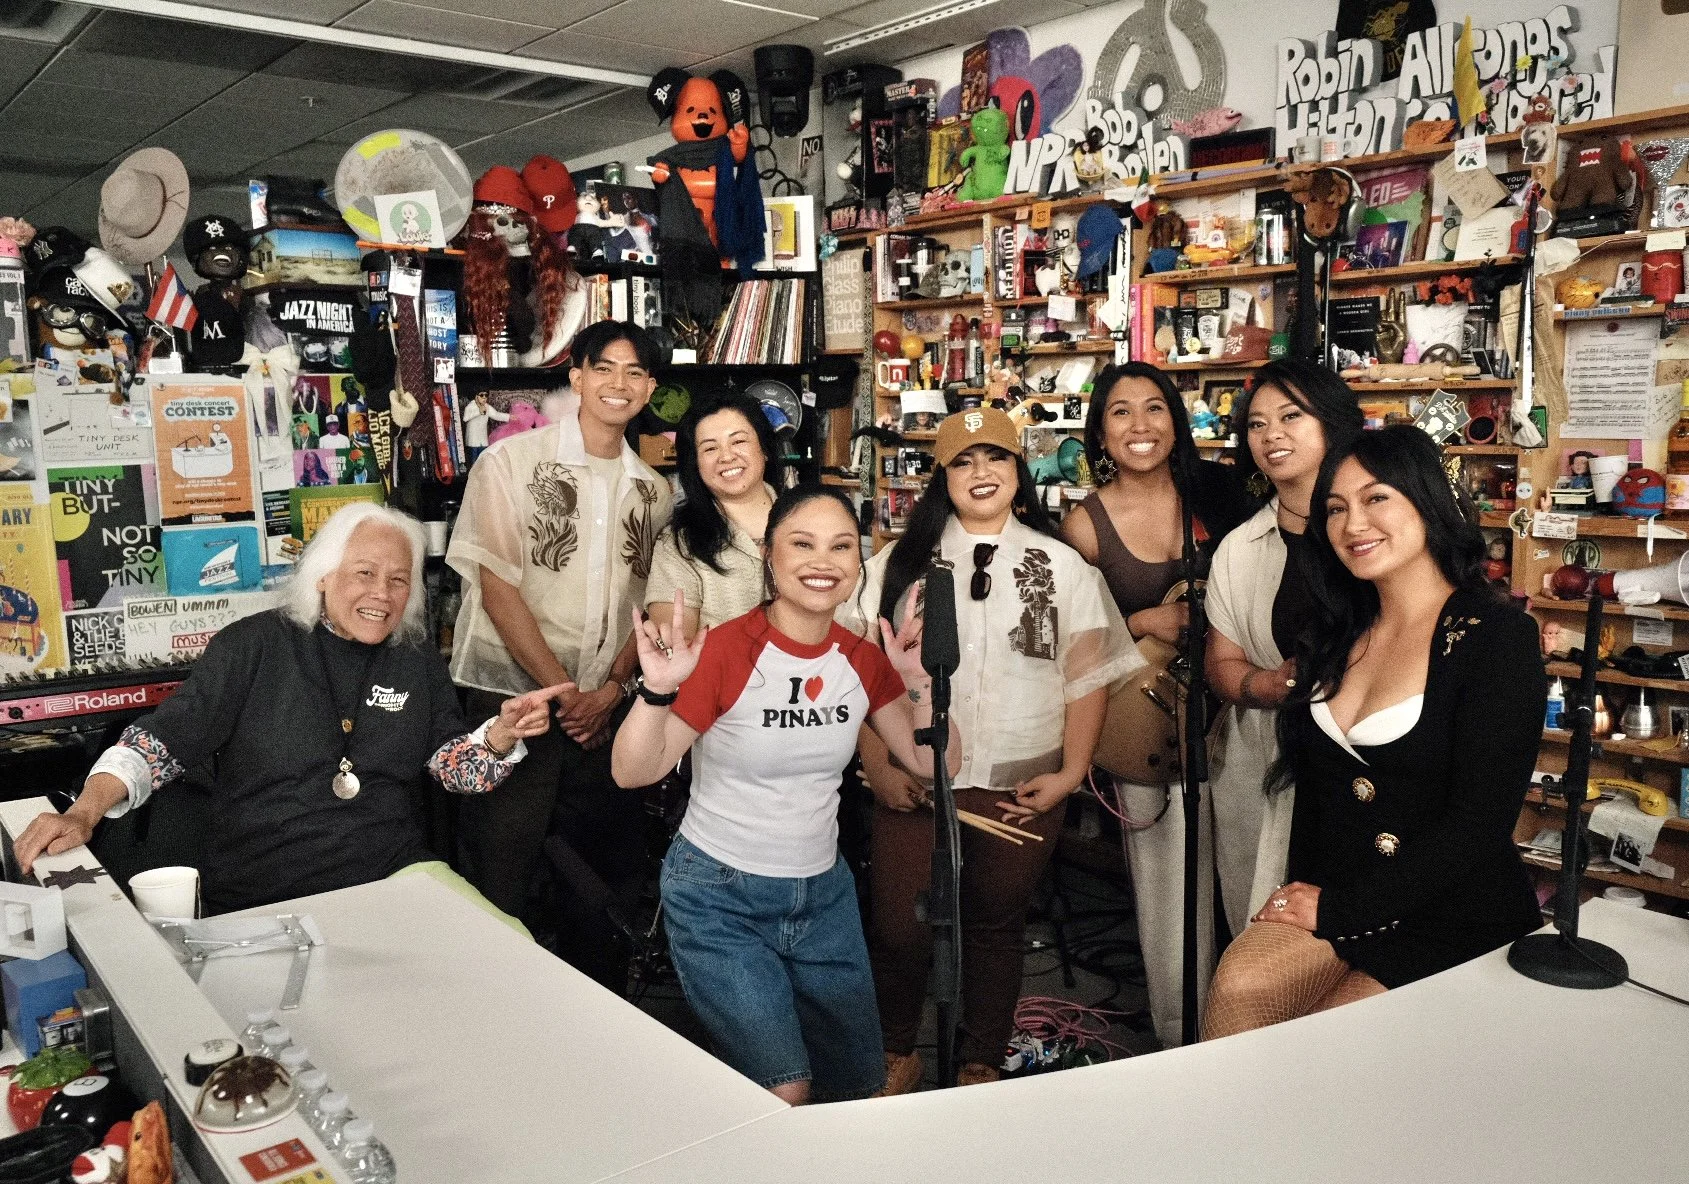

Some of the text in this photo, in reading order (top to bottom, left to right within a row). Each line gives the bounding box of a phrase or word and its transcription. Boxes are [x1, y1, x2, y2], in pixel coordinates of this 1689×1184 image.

[1275, 30, 1375, 110] Robin
[1398, 21, 1455, 104] All
[1085, 91, 1140, 151] Bob
[1274, 92, 1402, 162] Hilton
[803, 138, 821, 156] NO
[1104, 121, 1188, 181] Boilen
[1003, 130, 1090, 197] NPR
[542, 195, 555, 209] P
[280, 300, 353, 320] JAZZ NIGHT
[203, 320, 226, 340] M
[306, 319, 355, 332] IN AMERICA
[165, 406, 234, 417] CONTEST
[96, 443, 121, 451] UNIT
[370, 433, 386, 470] MAGIC
[58, 475, 118, 495] TINY
[61, 494, 121, 516] BUT-
[102, 525, 155, 547] NOT
[123, 546, 157, 565] SO
[102, 566, 159, 588] TINY
[131, 603, 174, 618] BOWEN
[72, 616, 111, 632] NICK
[129, 620, 158, 637] HEY
[74, 641, 126, 658] SEEDS
[176, 634, 212, 645] MUS
[74, 688, 147, 711] Roland
[366, 685, 410, 707] Fanny
[788, 677, 803, 705] I
[762, 705, 850, 729] PINAYS
